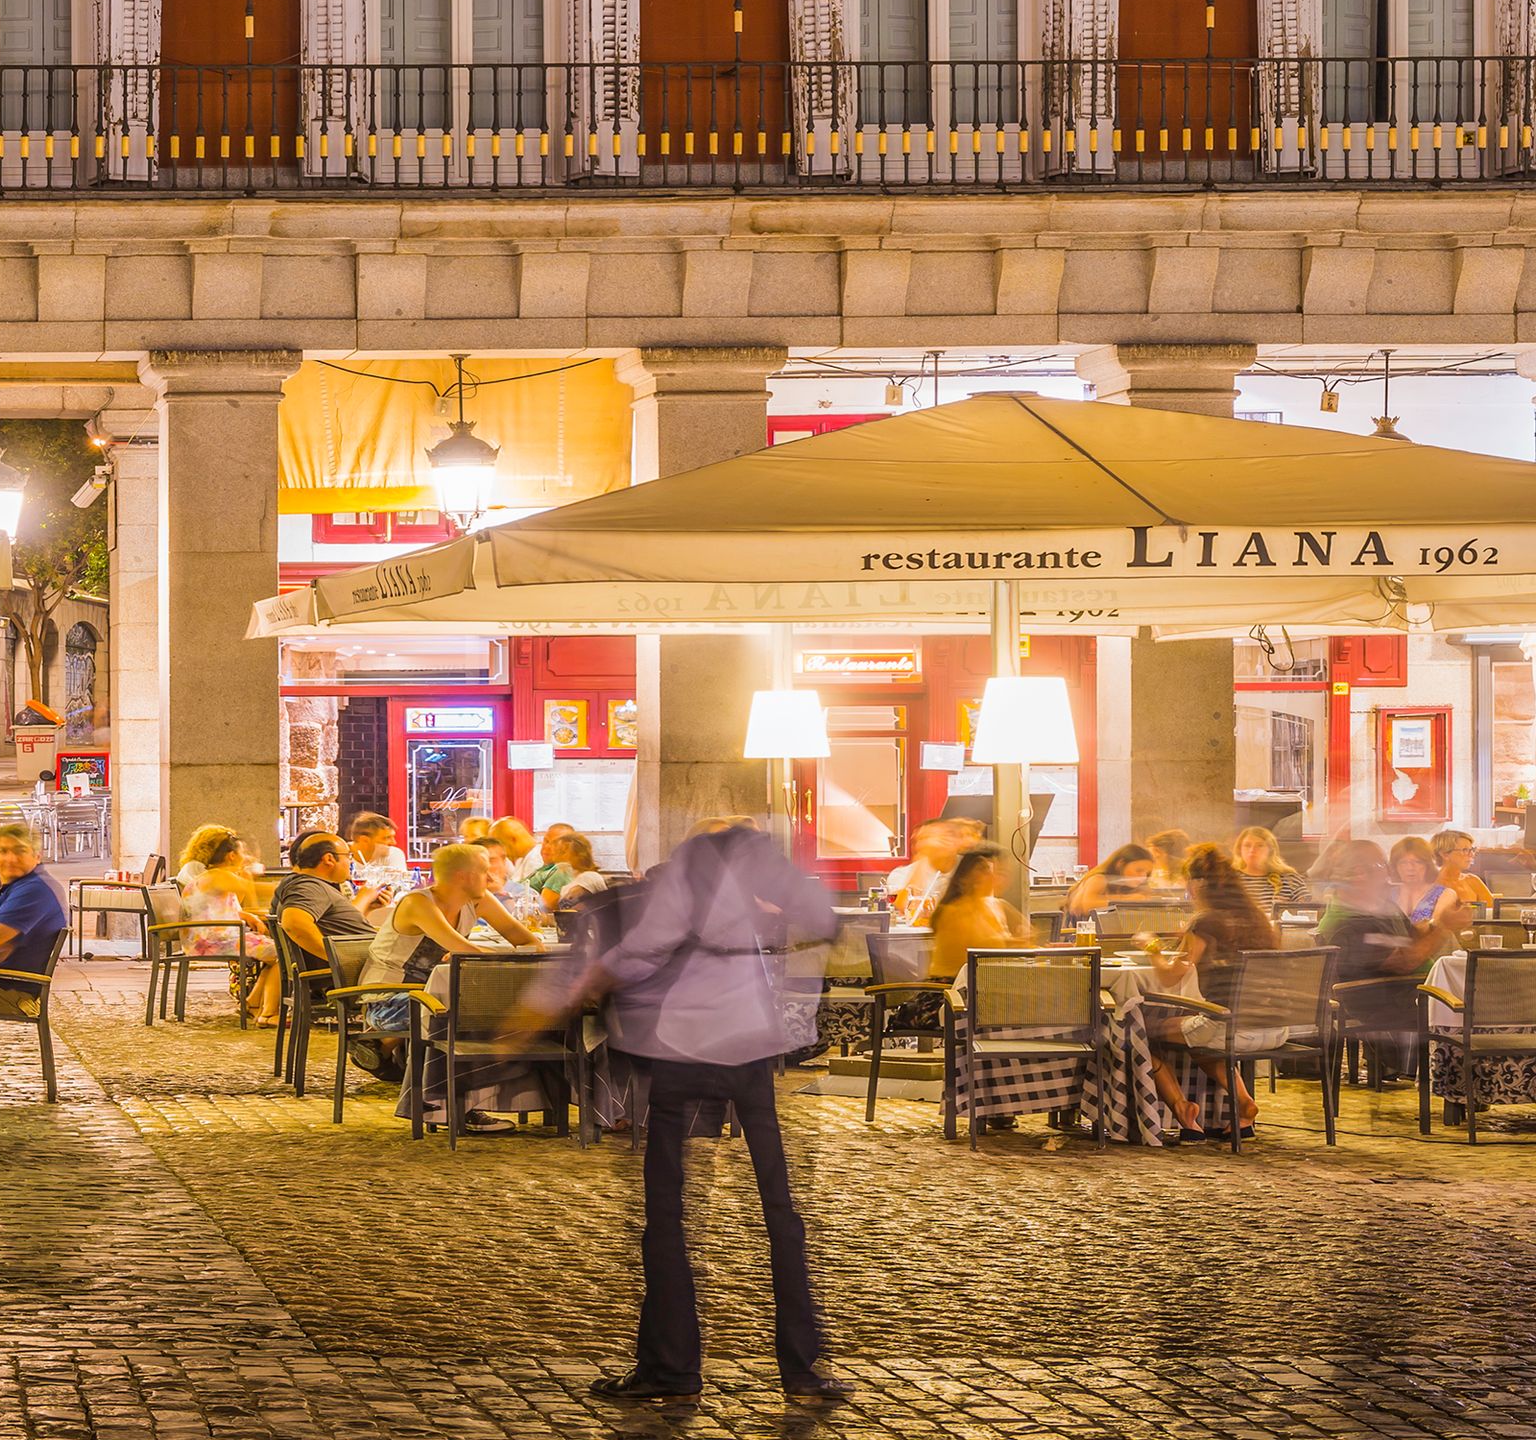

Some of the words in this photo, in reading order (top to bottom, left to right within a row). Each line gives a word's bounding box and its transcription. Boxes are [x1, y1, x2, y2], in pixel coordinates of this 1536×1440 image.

[860, 544, 1103, 571] restaurante
[1125, 525, 1396, 569] LIANA
[1418, 537, 1500, 575] 1962
[376, 563, 417, 599] LIANA
[804, 655, 914, 672] Restaurante
